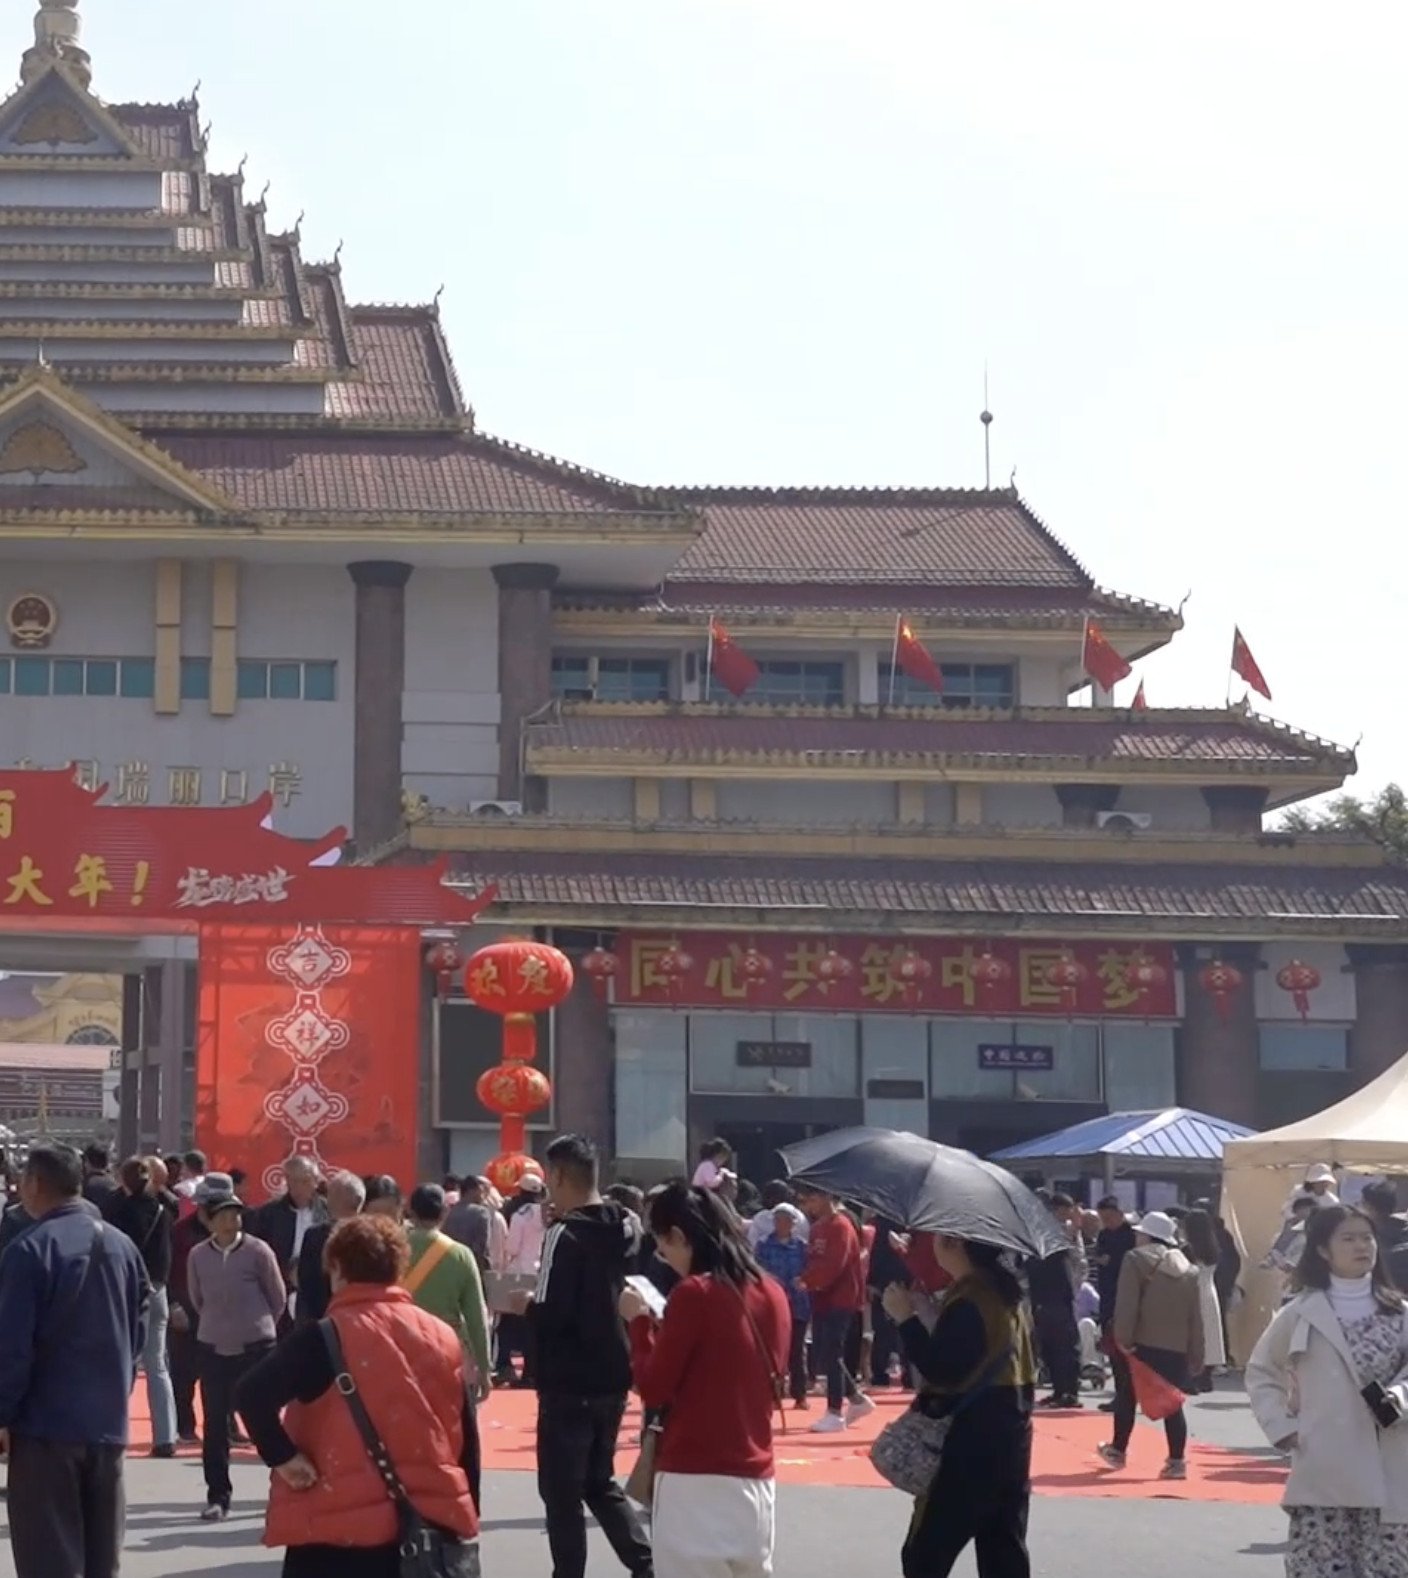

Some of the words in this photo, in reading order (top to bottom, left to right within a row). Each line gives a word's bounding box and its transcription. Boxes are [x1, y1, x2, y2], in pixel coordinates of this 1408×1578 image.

[631, 938, 1155, 1008] 同心共筑中国梦
